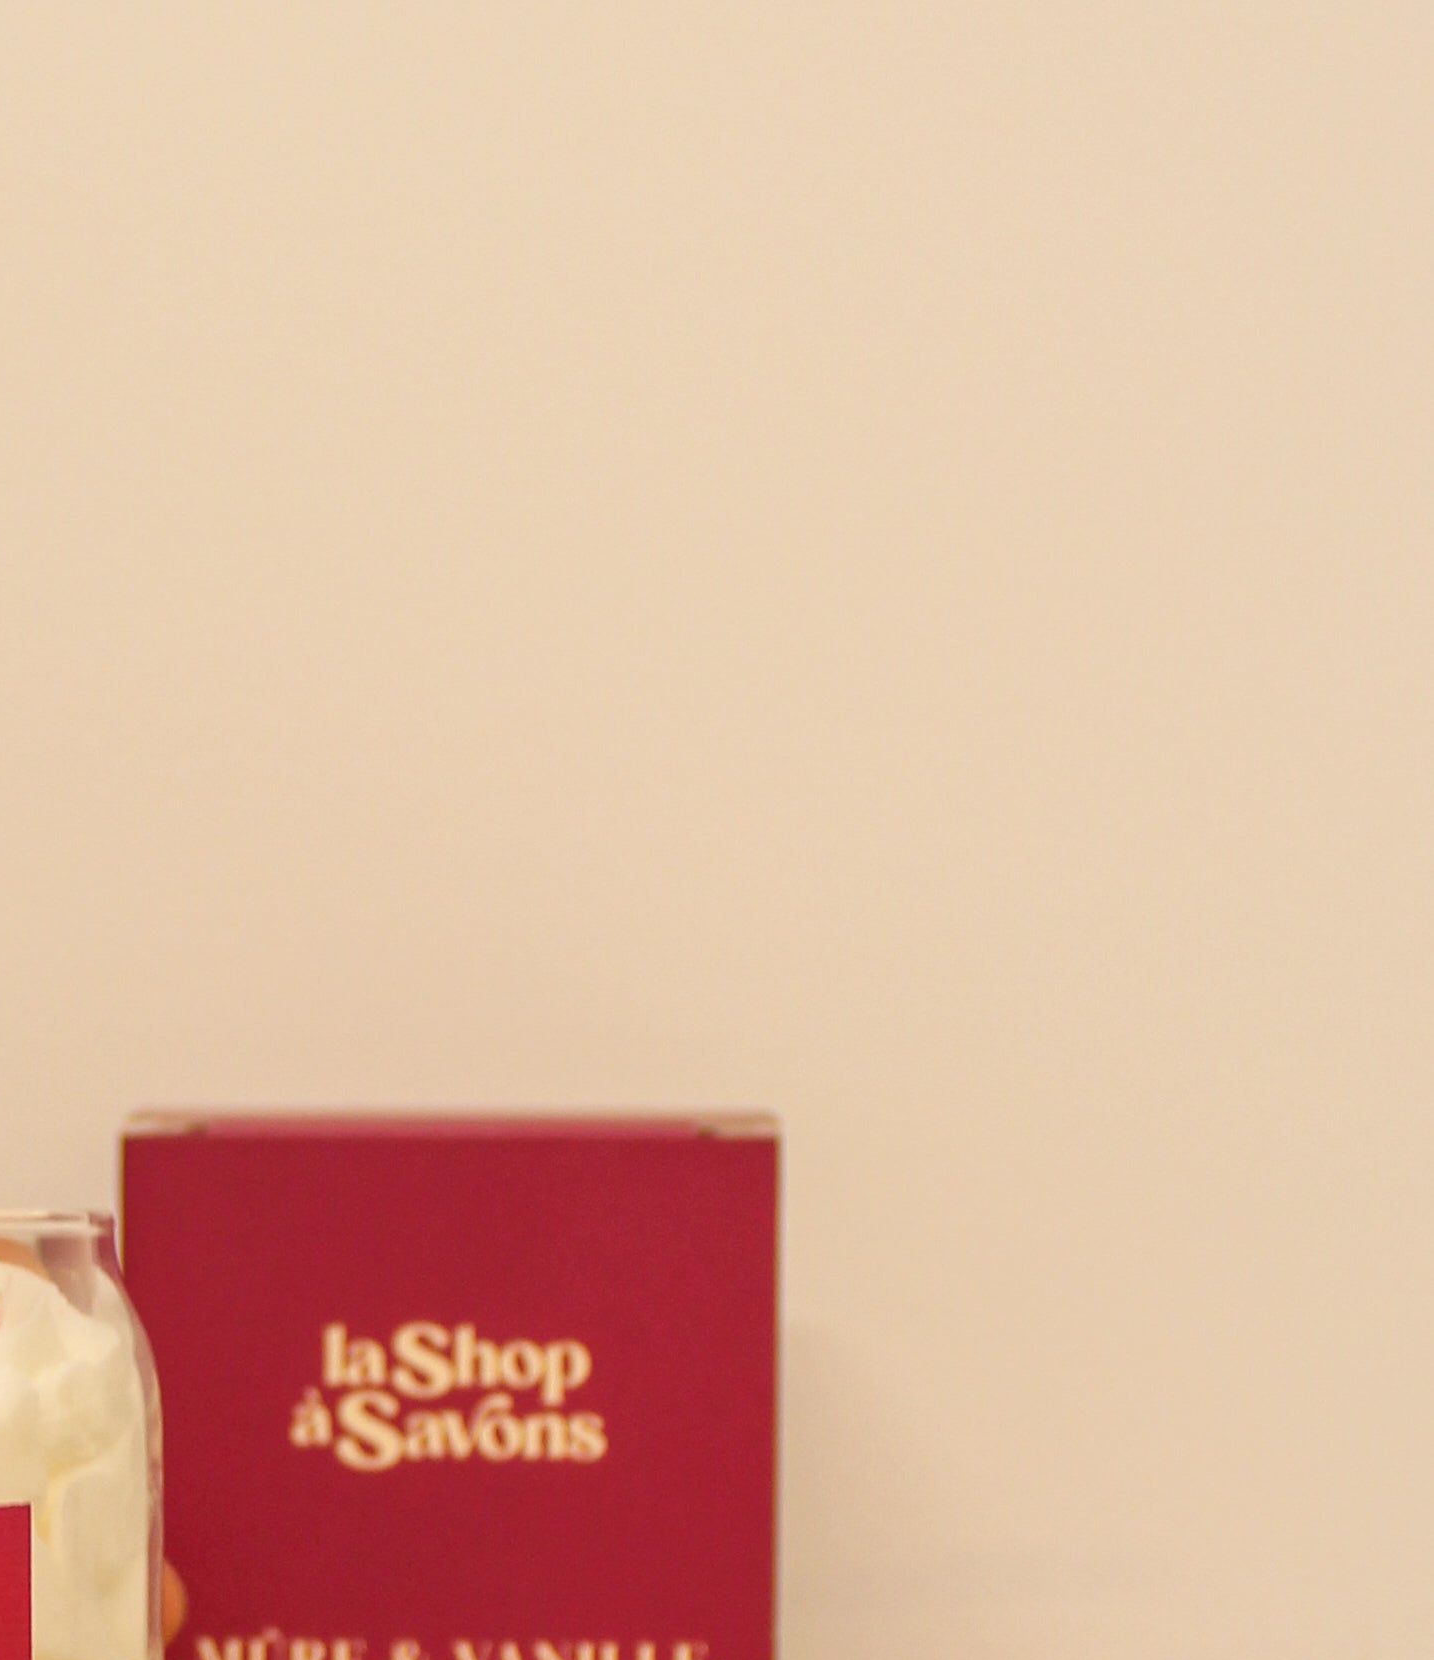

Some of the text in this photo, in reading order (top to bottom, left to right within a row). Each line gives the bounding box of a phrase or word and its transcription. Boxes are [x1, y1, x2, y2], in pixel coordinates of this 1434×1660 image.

[322, 1320, 592, 1406] la Shop
[288, 1386, 608, 1471] à Savons
